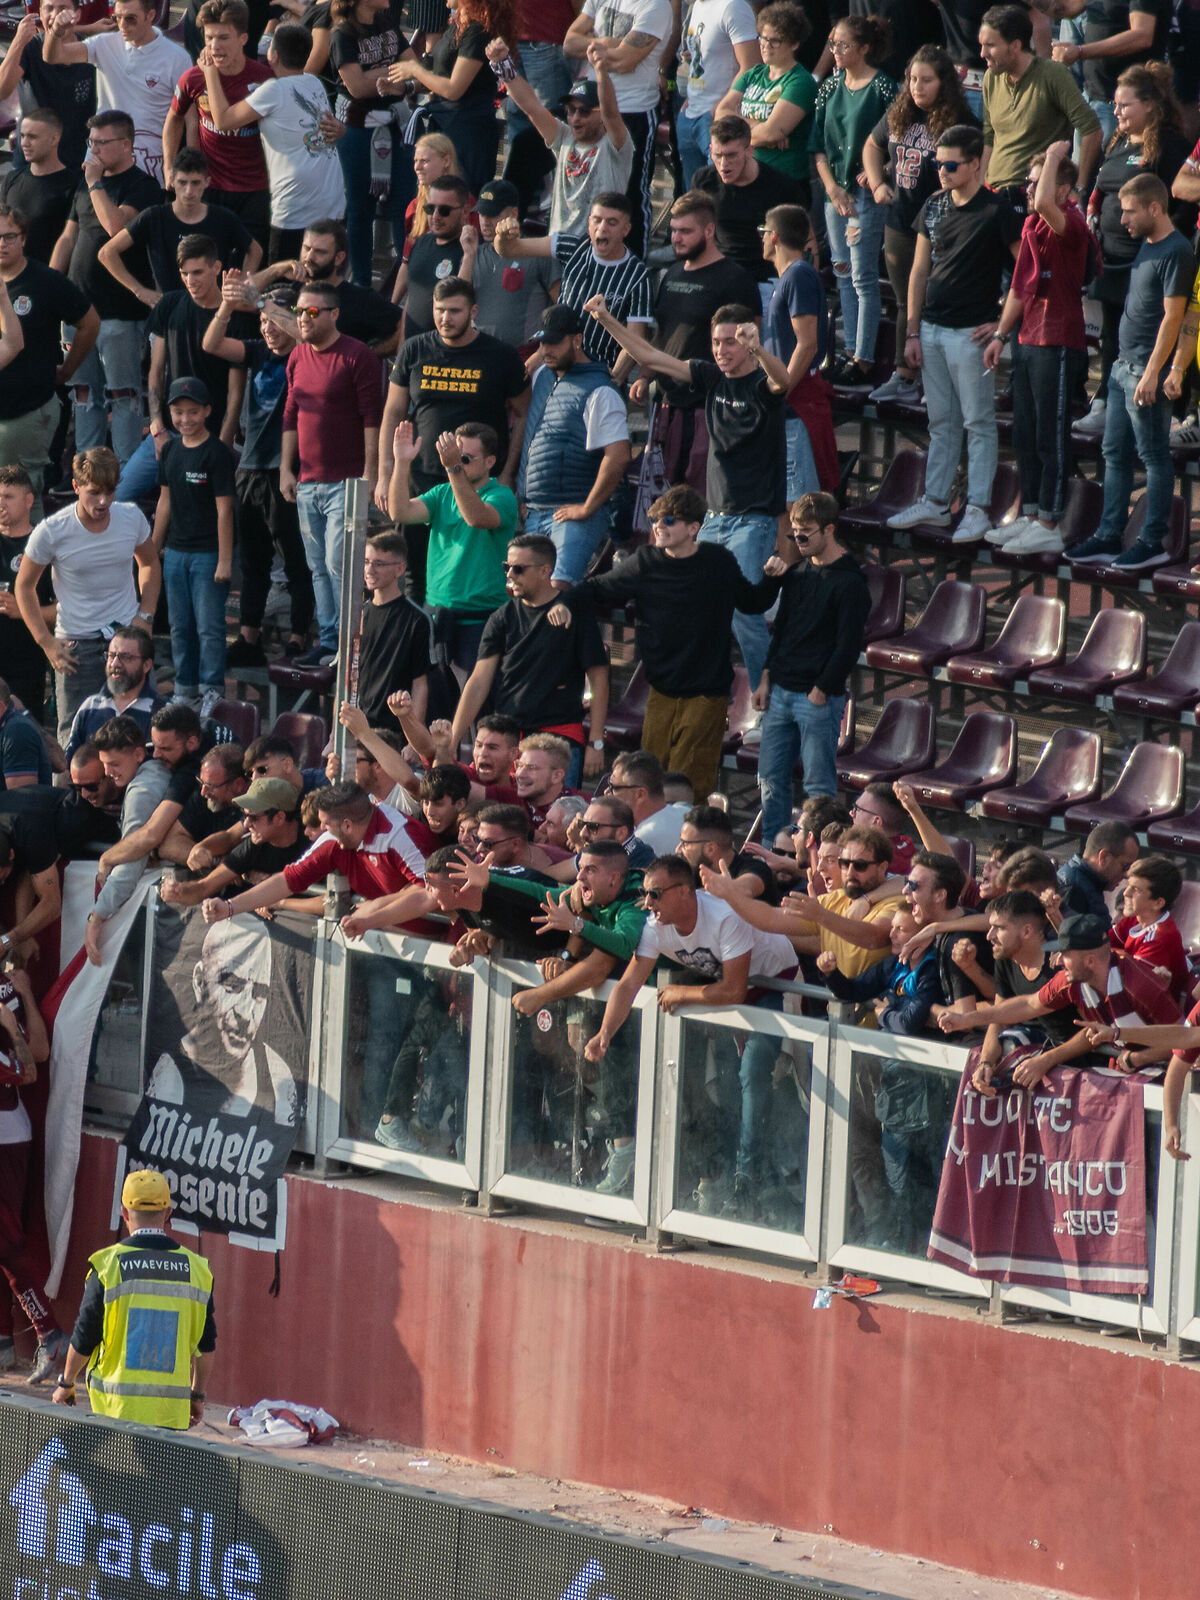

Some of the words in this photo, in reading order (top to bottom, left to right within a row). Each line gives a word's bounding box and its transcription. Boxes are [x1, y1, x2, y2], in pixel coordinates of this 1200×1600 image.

[423, 365, 481, 380] ULTRAS
[420, 379, 478, 393] LIBERI
[139, 1102, 274, 1180] Michele
[120, 1259, 190, 1273] VIVAEVENTS
